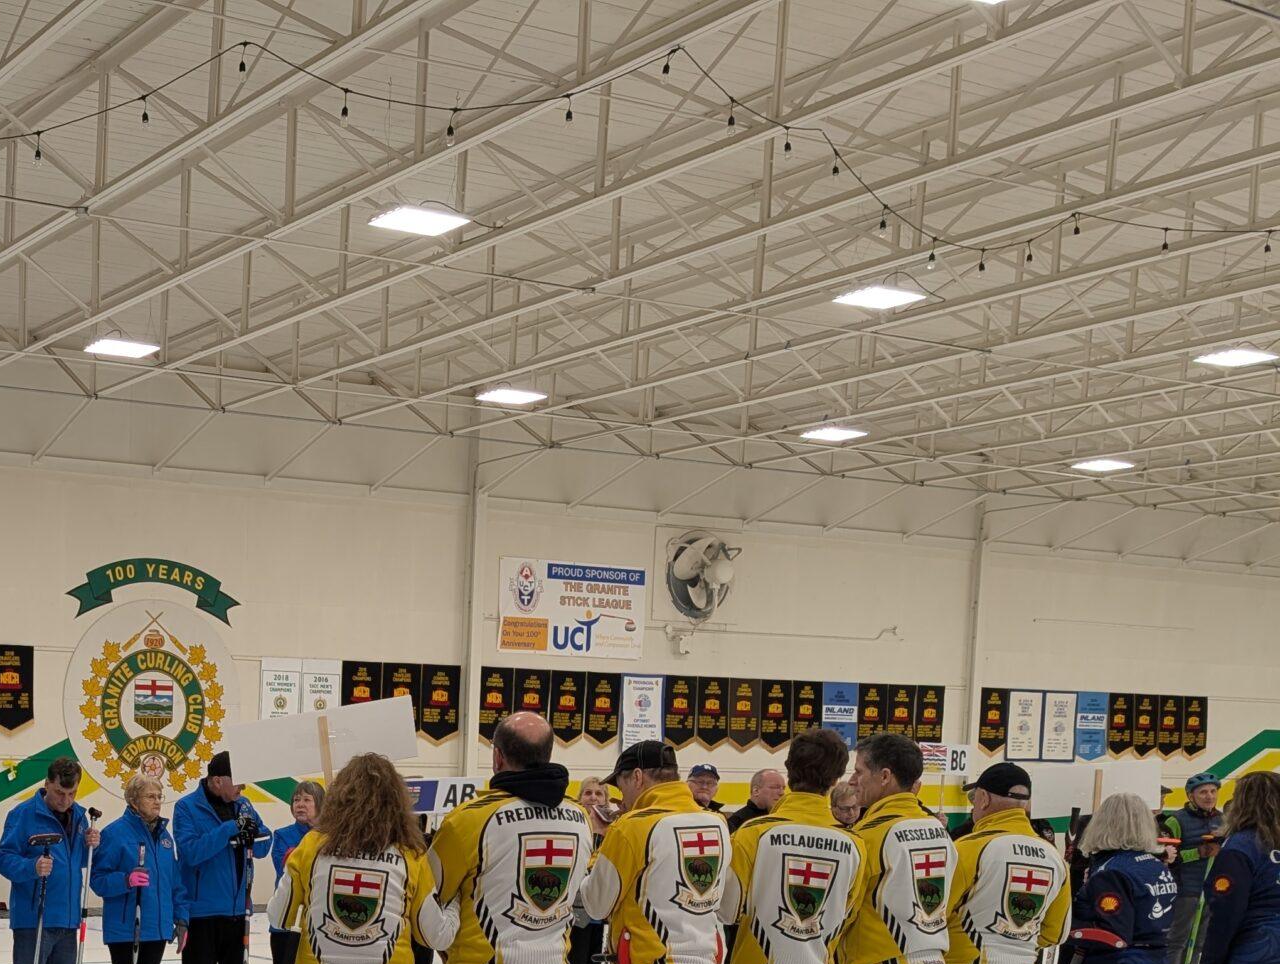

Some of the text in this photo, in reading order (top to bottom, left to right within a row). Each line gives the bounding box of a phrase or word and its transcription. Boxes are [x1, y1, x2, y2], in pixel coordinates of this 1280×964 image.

[106, 563, 205, 590] 100 YEARS
[552, 567, 641, 581] PROUD SPONSOR OF
[563, 582, 629, 596] THE GRANITE
[560, 596, 632, 610] STICK LEAGUE
[552, 622, 599, 653] UCT
[105, 652, 202, 734] GRANITE CURLING CLUB
[824, 706, 855, 715] INLAND
[122, 736, 184, 764] EDMONTON
[951, 750, 967, 771] BC
[443, 784, 476, 807] AB
[495, 806, 586, 826] FREDRICKSON
[770, 833, 852, 855] MCLAUGHLIN
[894, 827, 948, 843] HESSELBAR
[1012, 843, 1046, 859] LYONS
[520, 912, 558, 924] MANITOBA
[333, 930, 371, 942] MANITOBA
